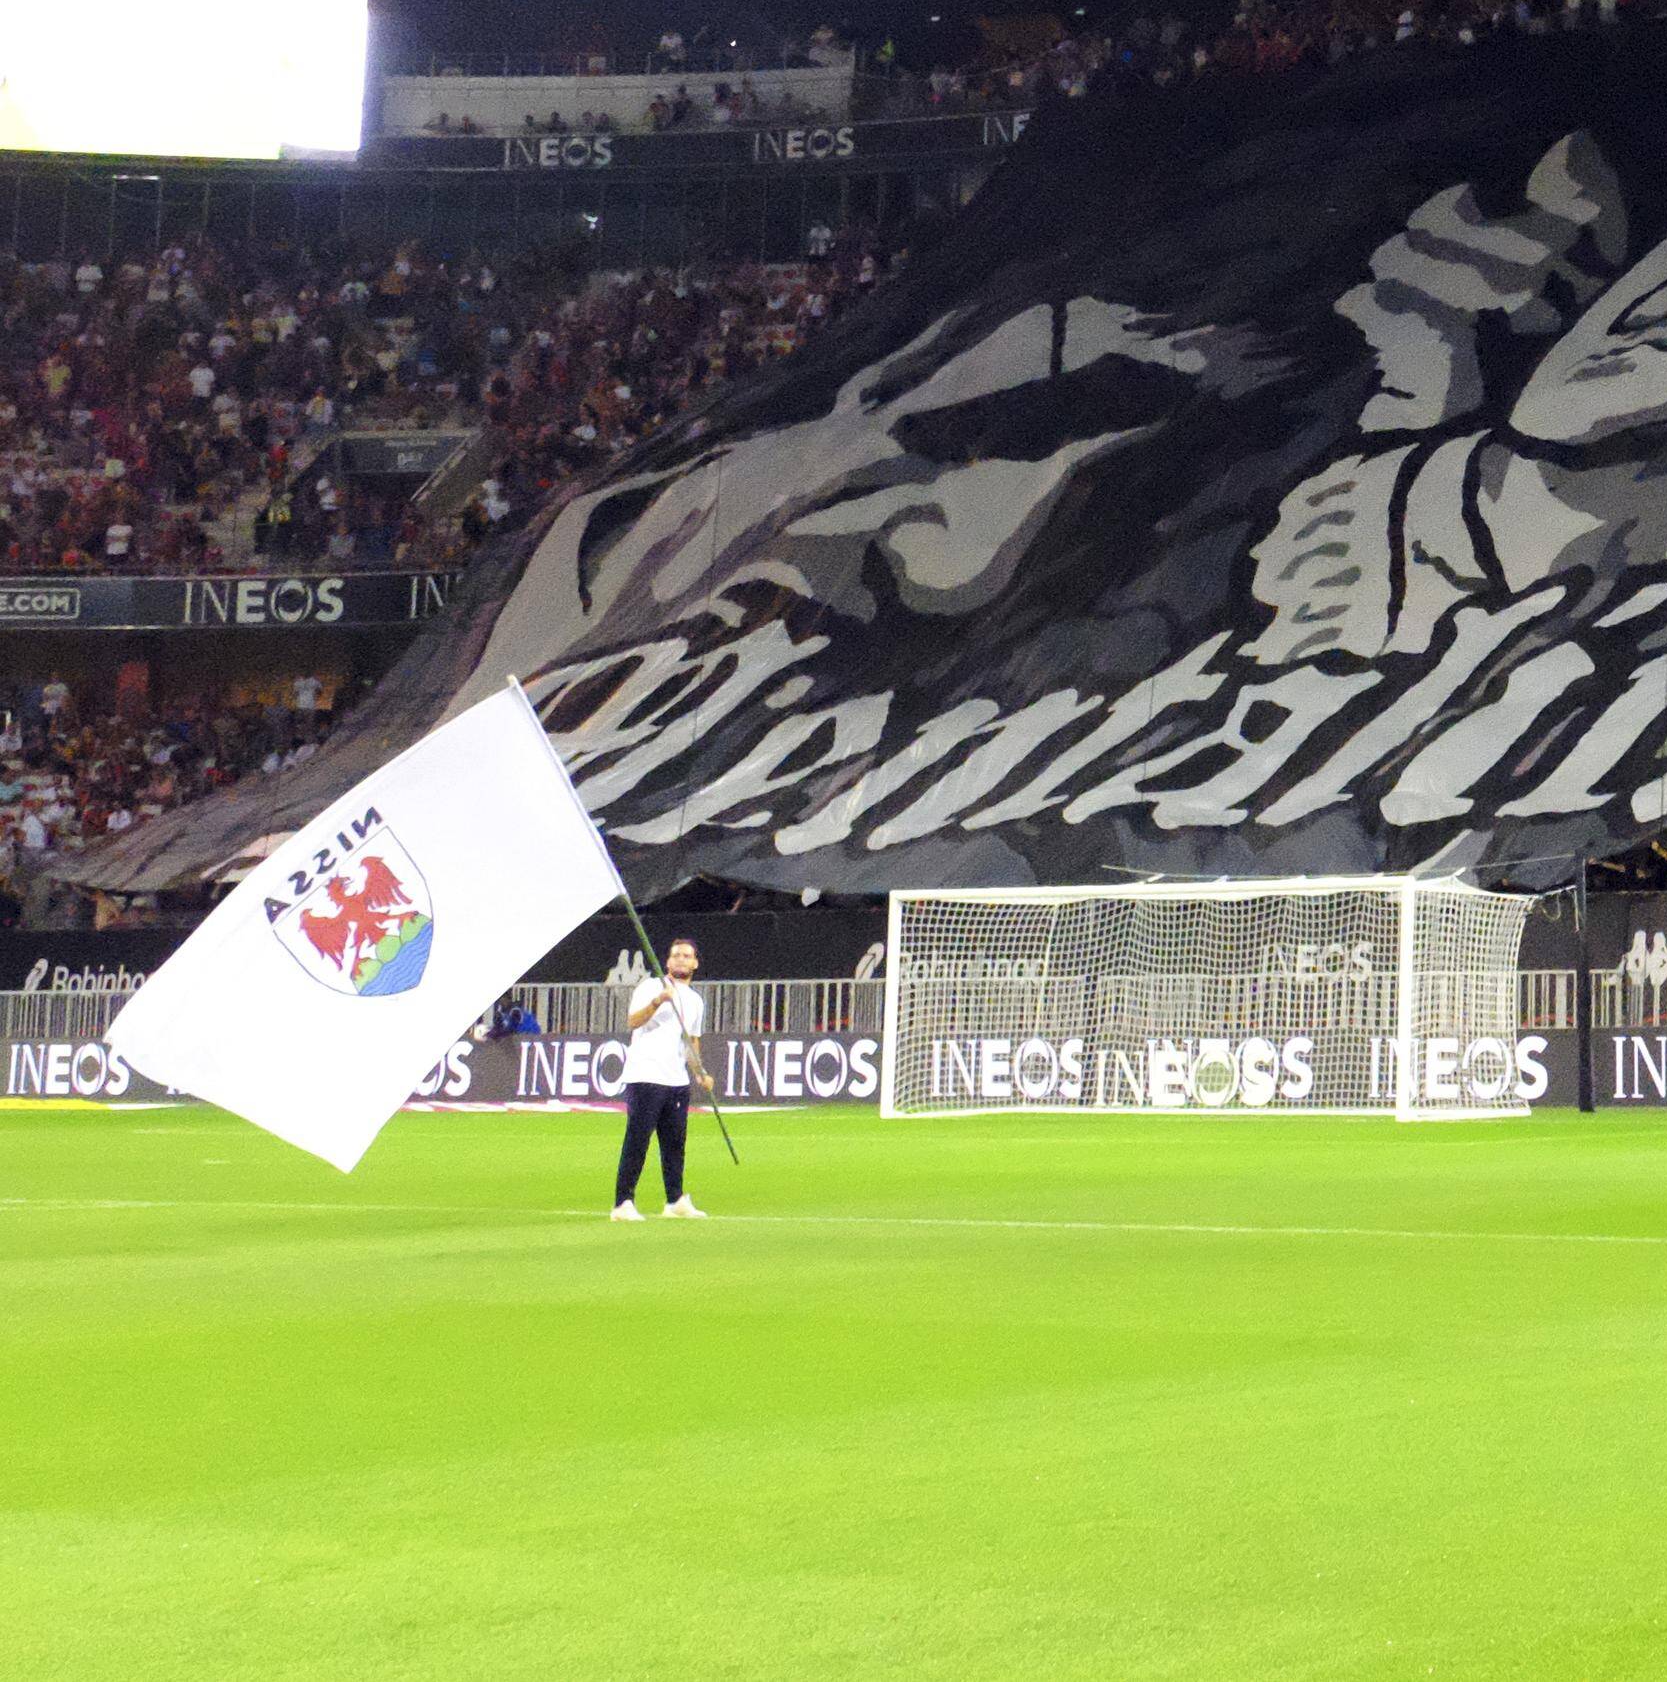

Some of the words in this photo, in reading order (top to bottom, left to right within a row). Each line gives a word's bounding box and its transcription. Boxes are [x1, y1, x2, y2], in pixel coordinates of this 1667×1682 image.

[503, 136, 614, 170] INEOS
[752, 127, 856, 163] INEOS
[184, 578, 344, 624] INEOS
[6, 1042, 130, 1097] INEOS
[516, 1040, 628, 1097] INEO
[725, 1038, 878, 1098] INEOS
[931, 1038, 1084, 1099] INEOS
